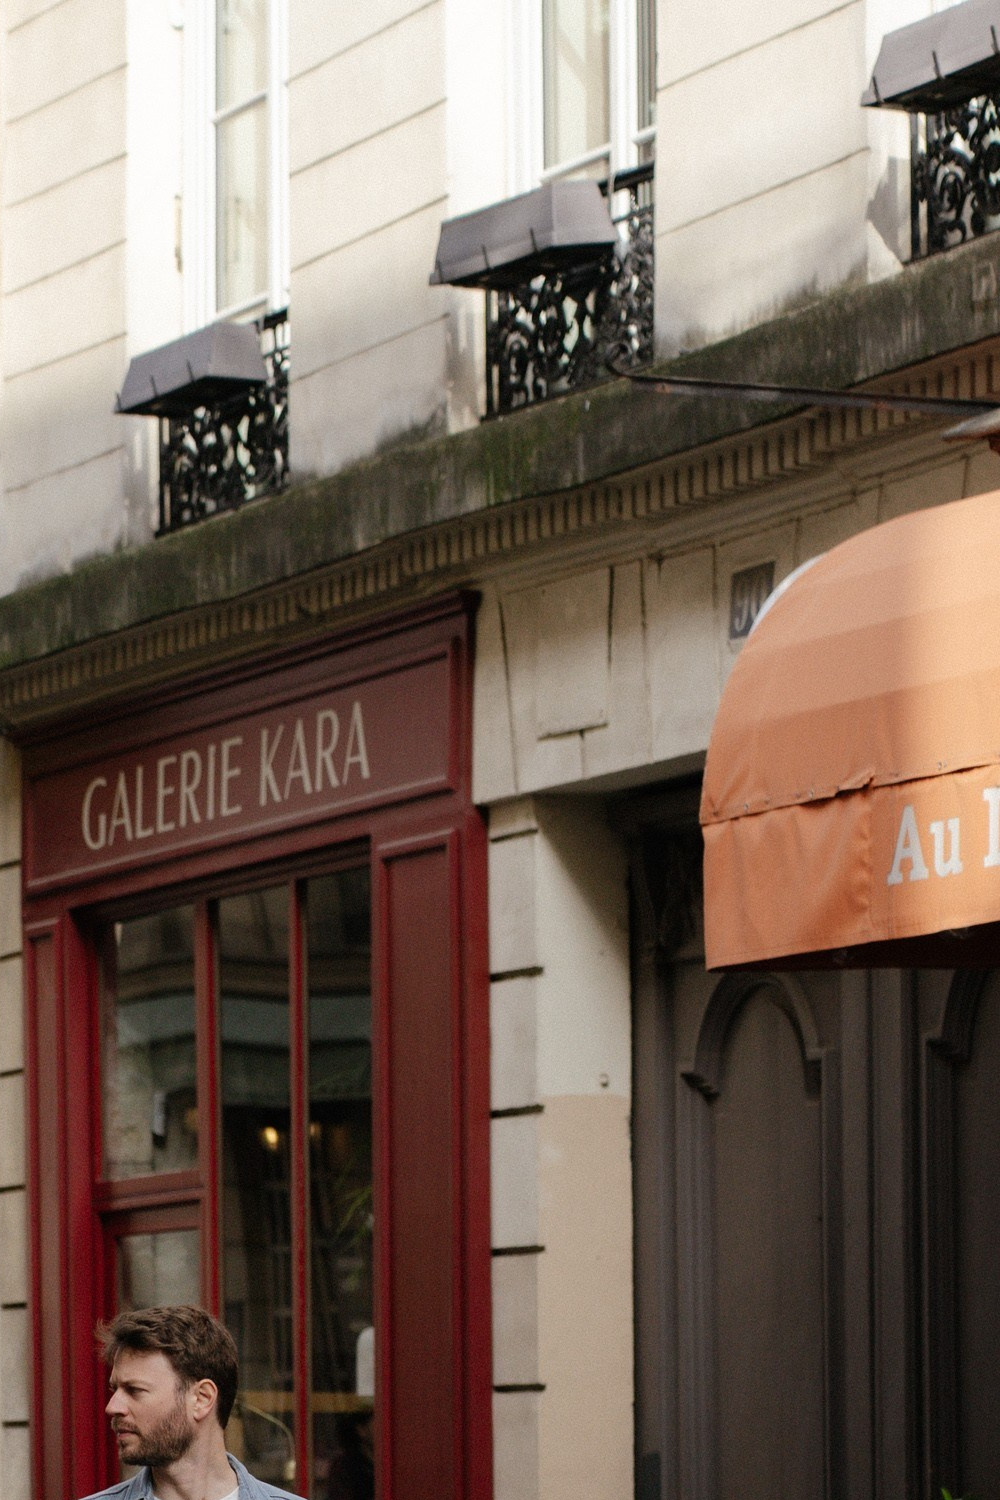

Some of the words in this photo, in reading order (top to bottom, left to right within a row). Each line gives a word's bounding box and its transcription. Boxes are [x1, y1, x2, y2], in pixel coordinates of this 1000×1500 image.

[81, 736, 244, 850] GALERIE
[259, 701, 371, 807] KARA
[886, 804, 963, 887] Au
